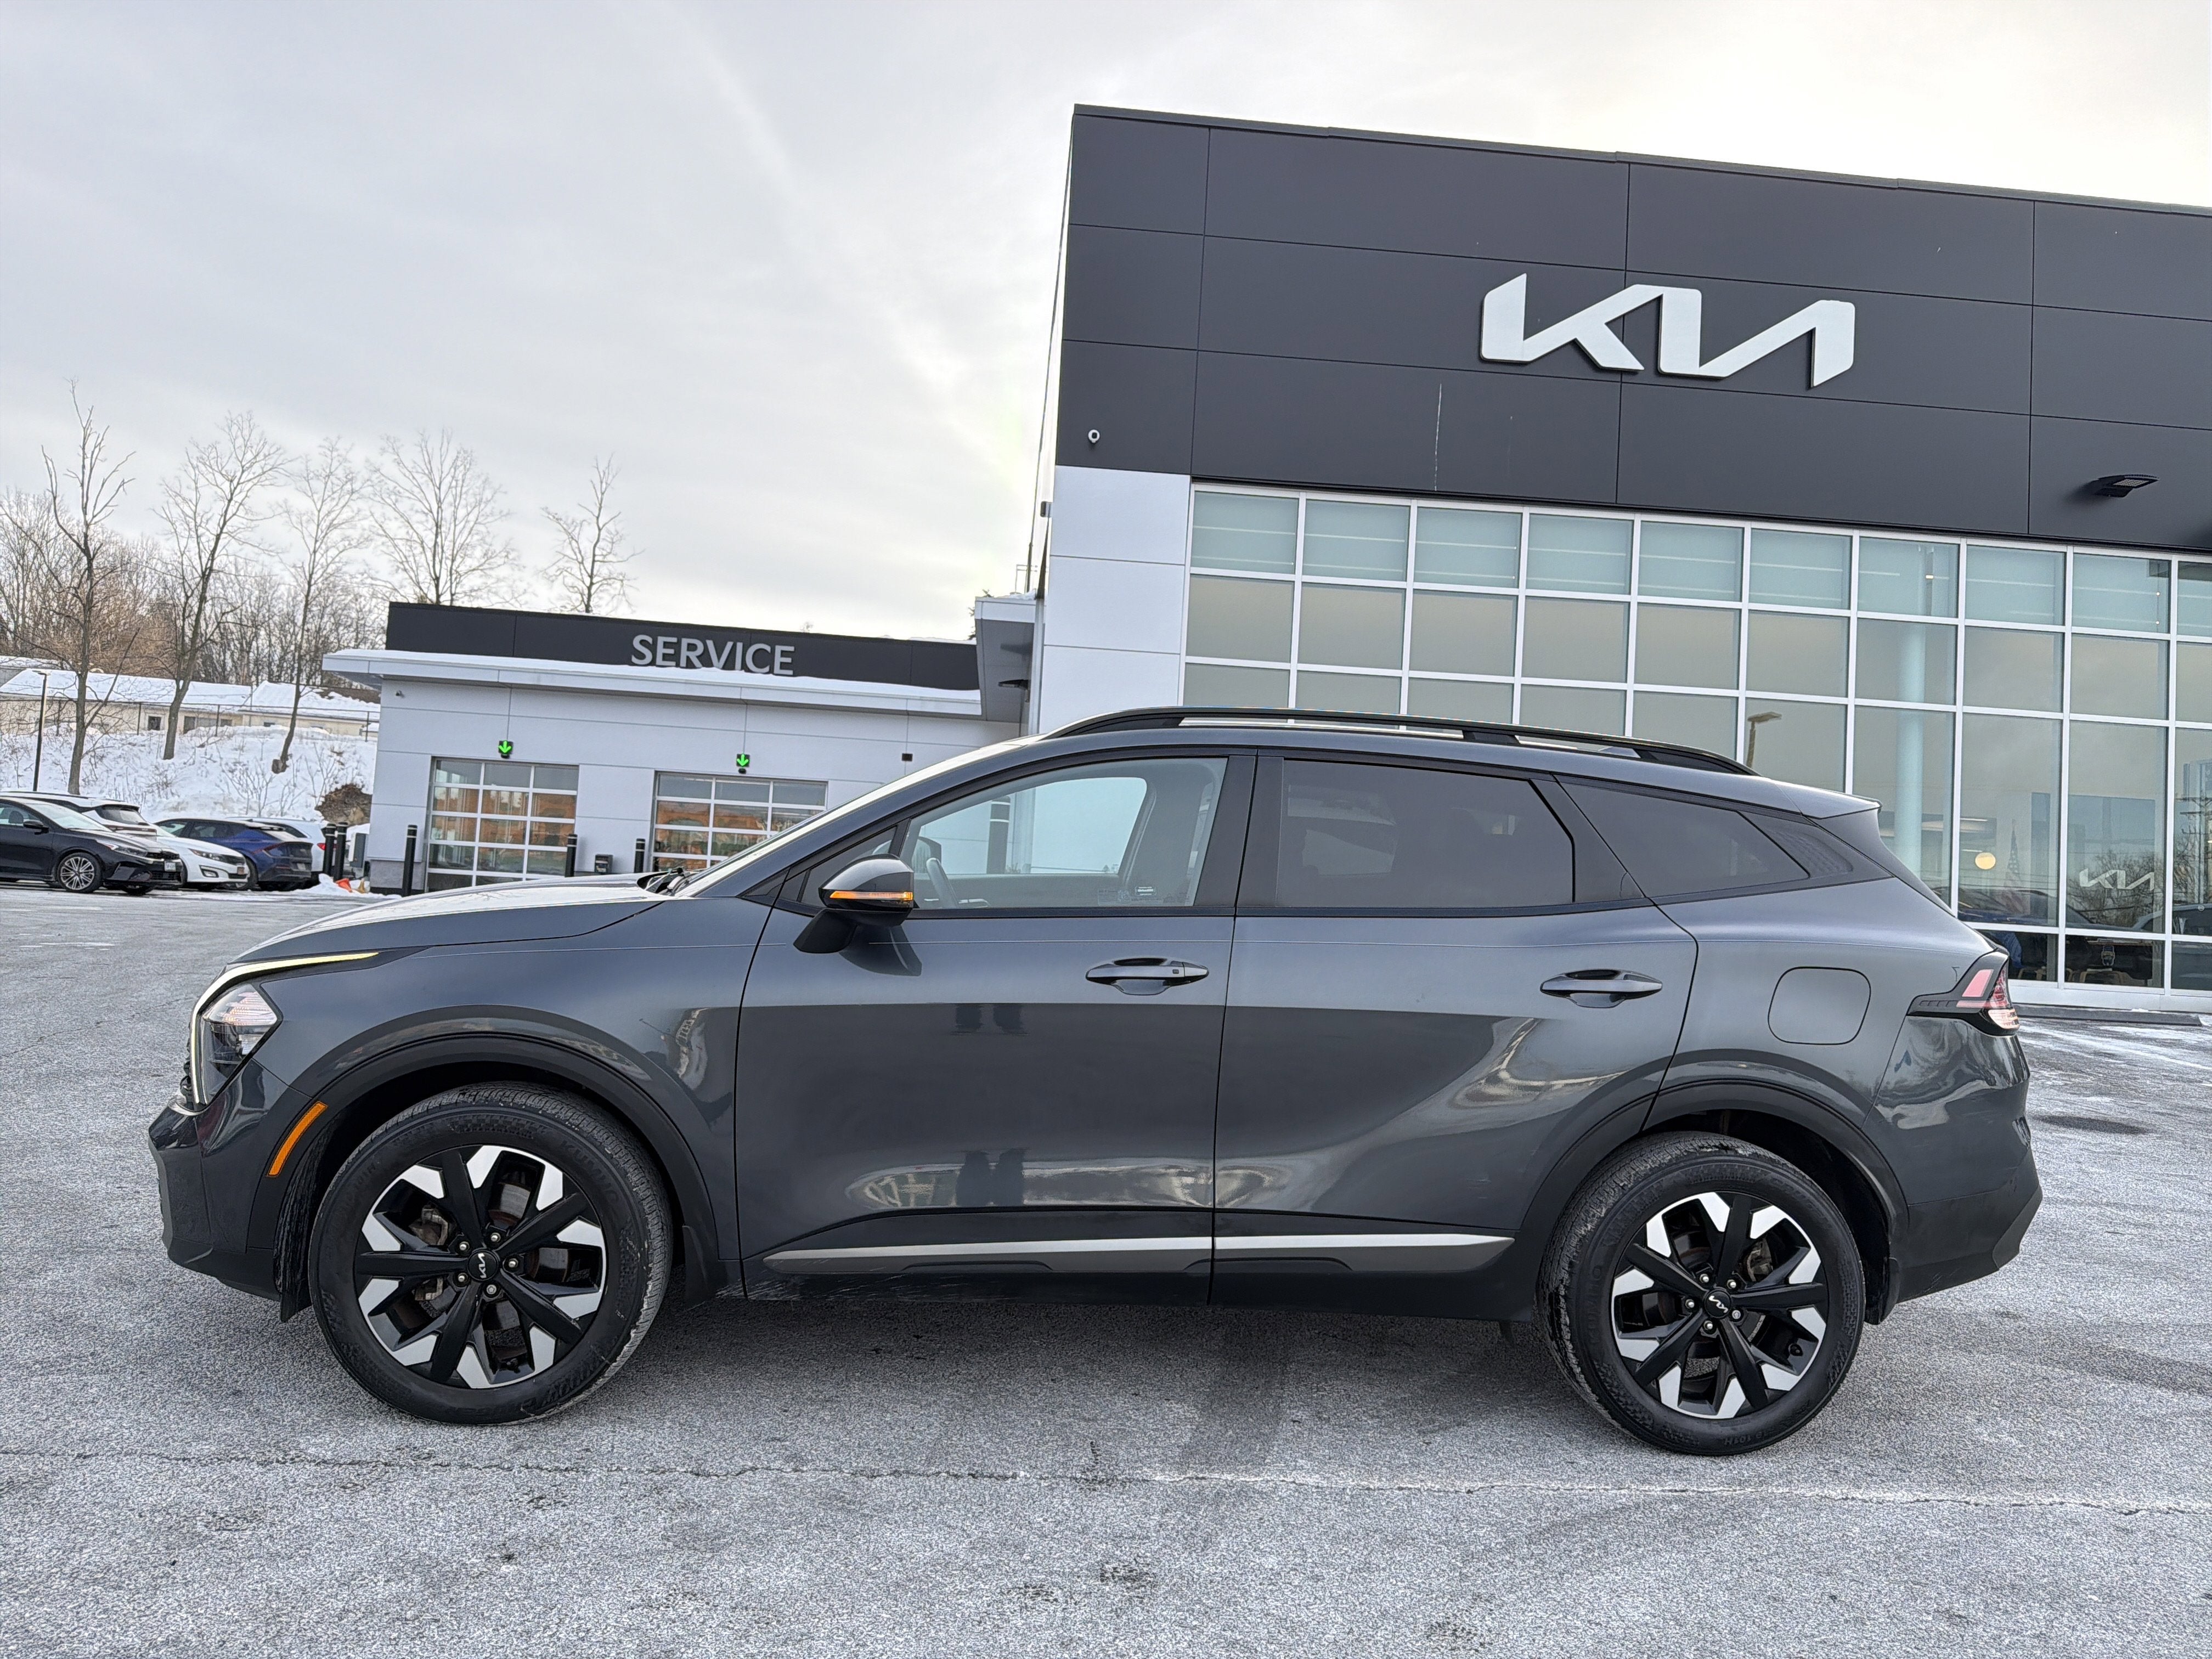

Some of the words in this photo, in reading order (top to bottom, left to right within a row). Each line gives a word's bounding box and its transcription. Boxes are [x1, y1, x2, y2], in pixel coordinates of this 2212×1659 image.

[1481, 273, 1855, 388] KIA
[631, 634, 795, 675] SERVICE
[2079, 868, 2154, 891] KIA
[478, 1253, 487, 1279] KIA
